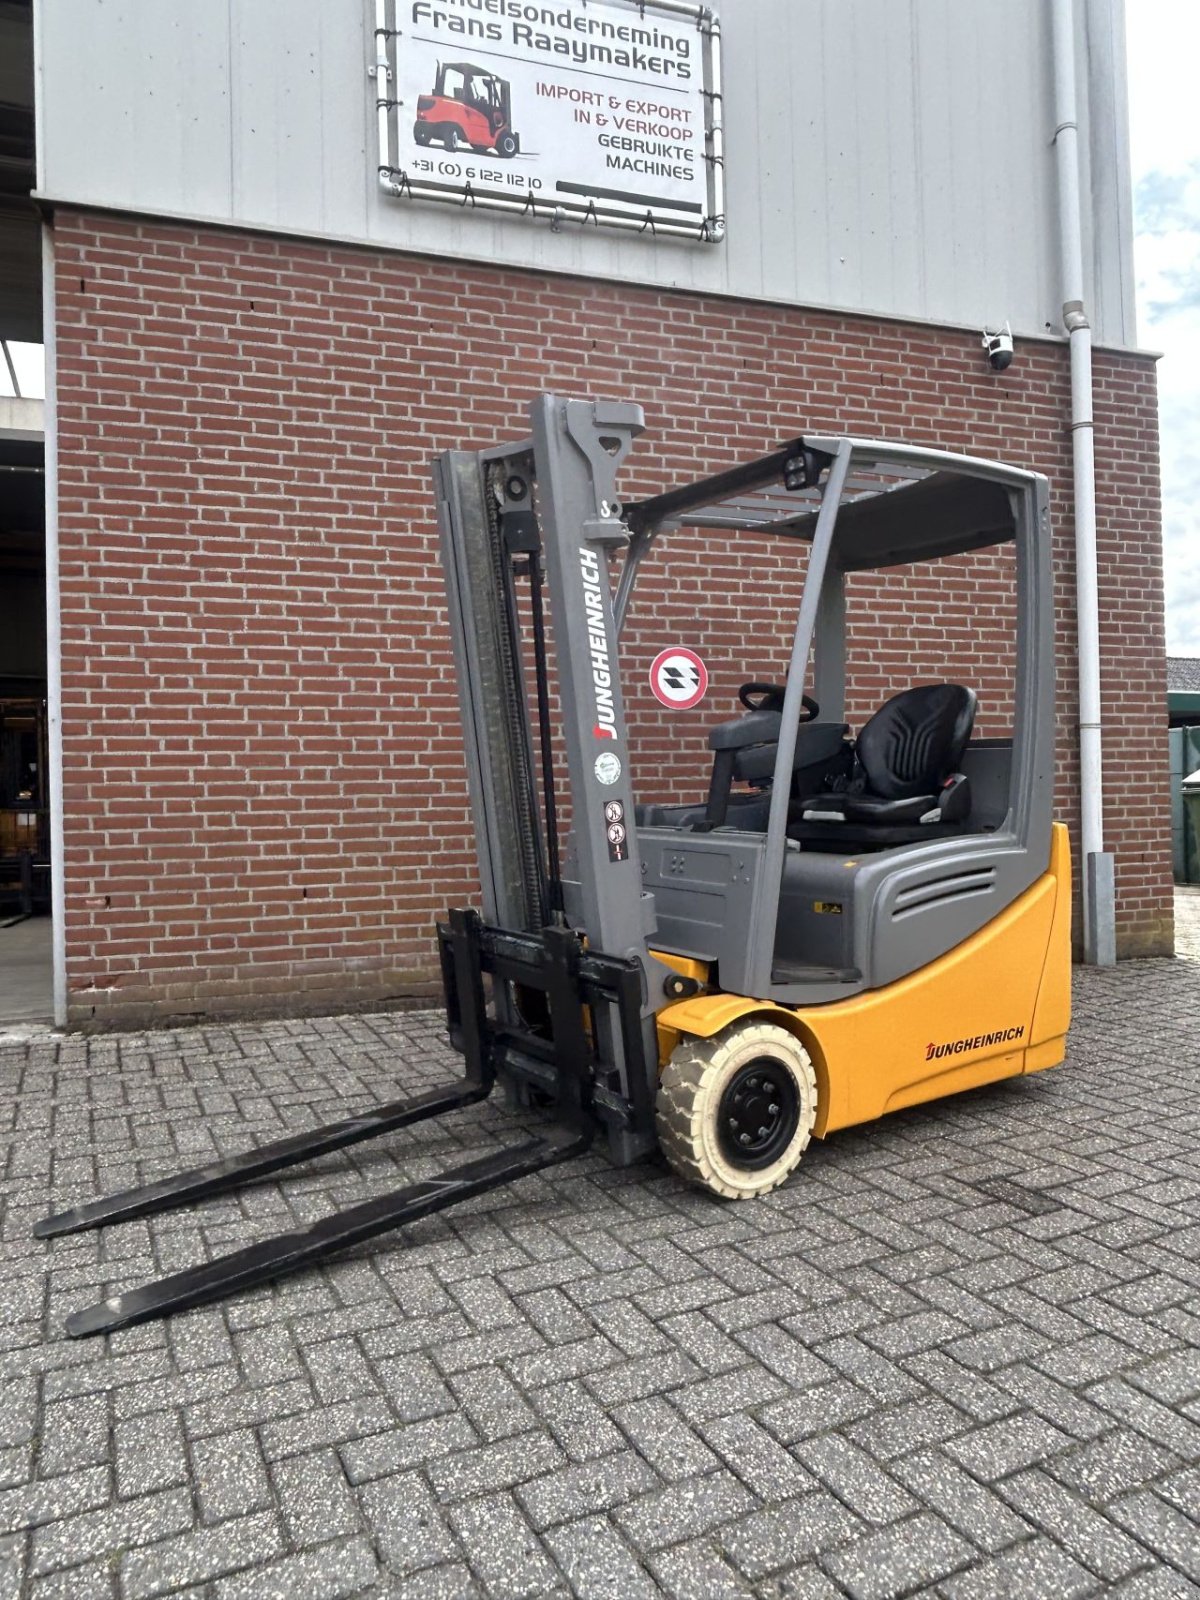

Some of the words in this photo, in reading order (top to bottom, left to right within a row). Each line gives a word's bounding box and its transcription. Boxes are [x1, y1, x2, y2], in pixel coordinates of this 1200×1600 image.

[412, 1, 503, 41] Frans
[512, 21, 691, 79] Raaymakers
[536, 82, 604, 106] IMPORT
[608, 96, 621, 109] &
[625, 99, 692, 123] EXPORT
[574, 109, 590, 124] IN
[596, 113, 608, 126] &
[613, 115, 693, 141] VERKOOP
[598, 133, 694, 162] GEBRUIKTE
[412, 159, 434, 172] +31
[438, 161, 461, 177] (0)
[465, 167, 476, 178] 6
[480, 169, 503, 183] 122
[507, 173, 525, 186] 112
[528, 177, 543, 189] 10
[606, 154, 694, 181] MACHINES
[579, 548, 618, 740] JUNGHEINRICH
[925, 1025, 1025, 1061] JUNGHEINRICH
